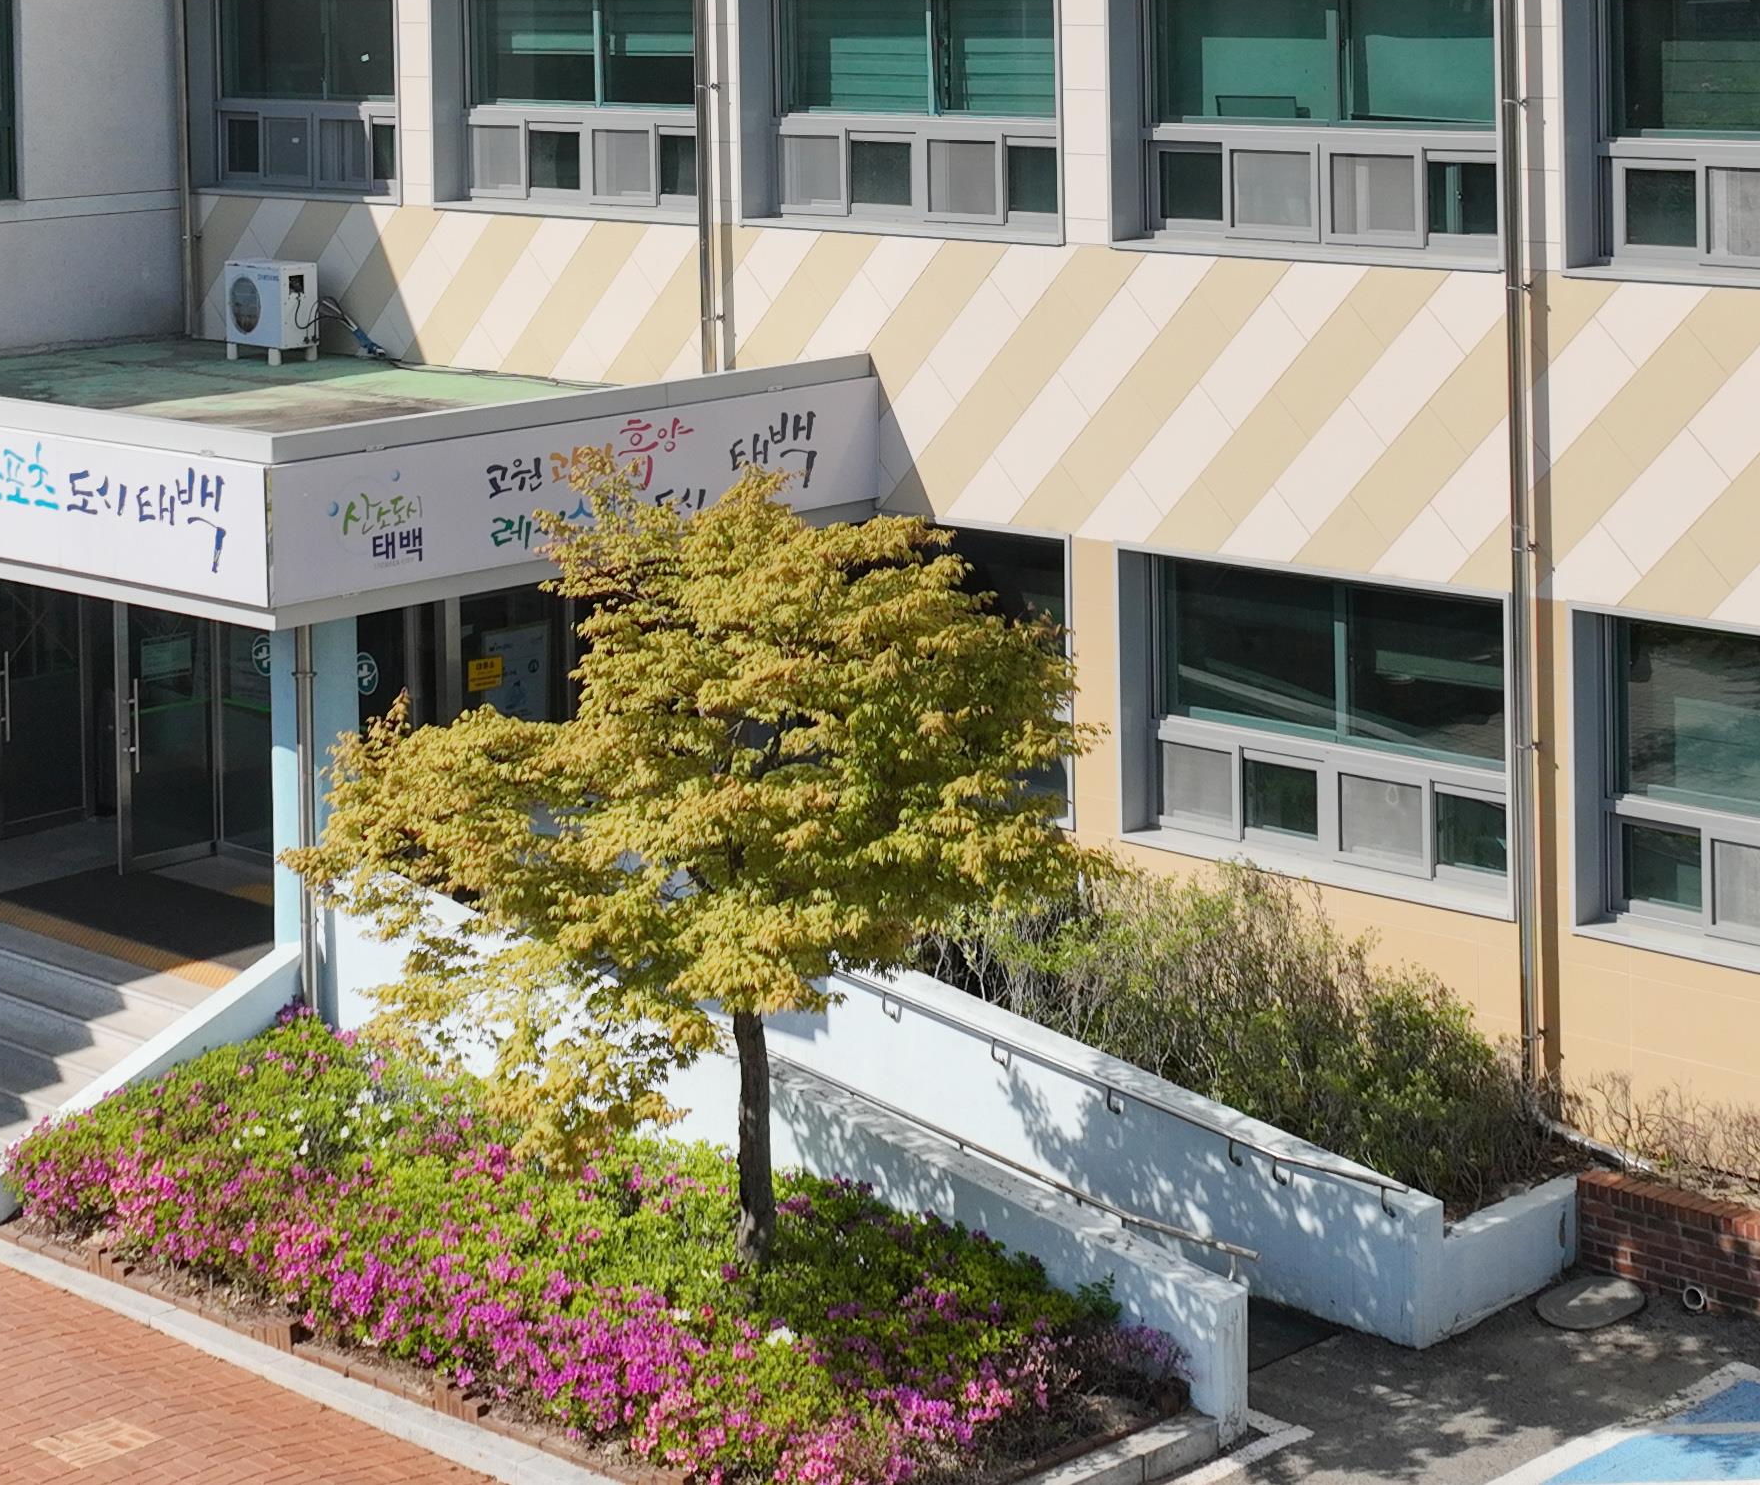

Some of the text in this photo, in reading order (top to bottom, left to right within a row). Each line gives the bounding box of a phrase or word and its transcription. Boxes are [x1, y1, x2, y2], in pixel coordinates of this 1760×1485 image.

[487, 457, 542, 498] 고원
[729, 411, 816, 488] 태백
[67, 470, 126, 516] 도시
[136, 467, 226, 573] 태백
[372, 527, 423, 562] 태백
